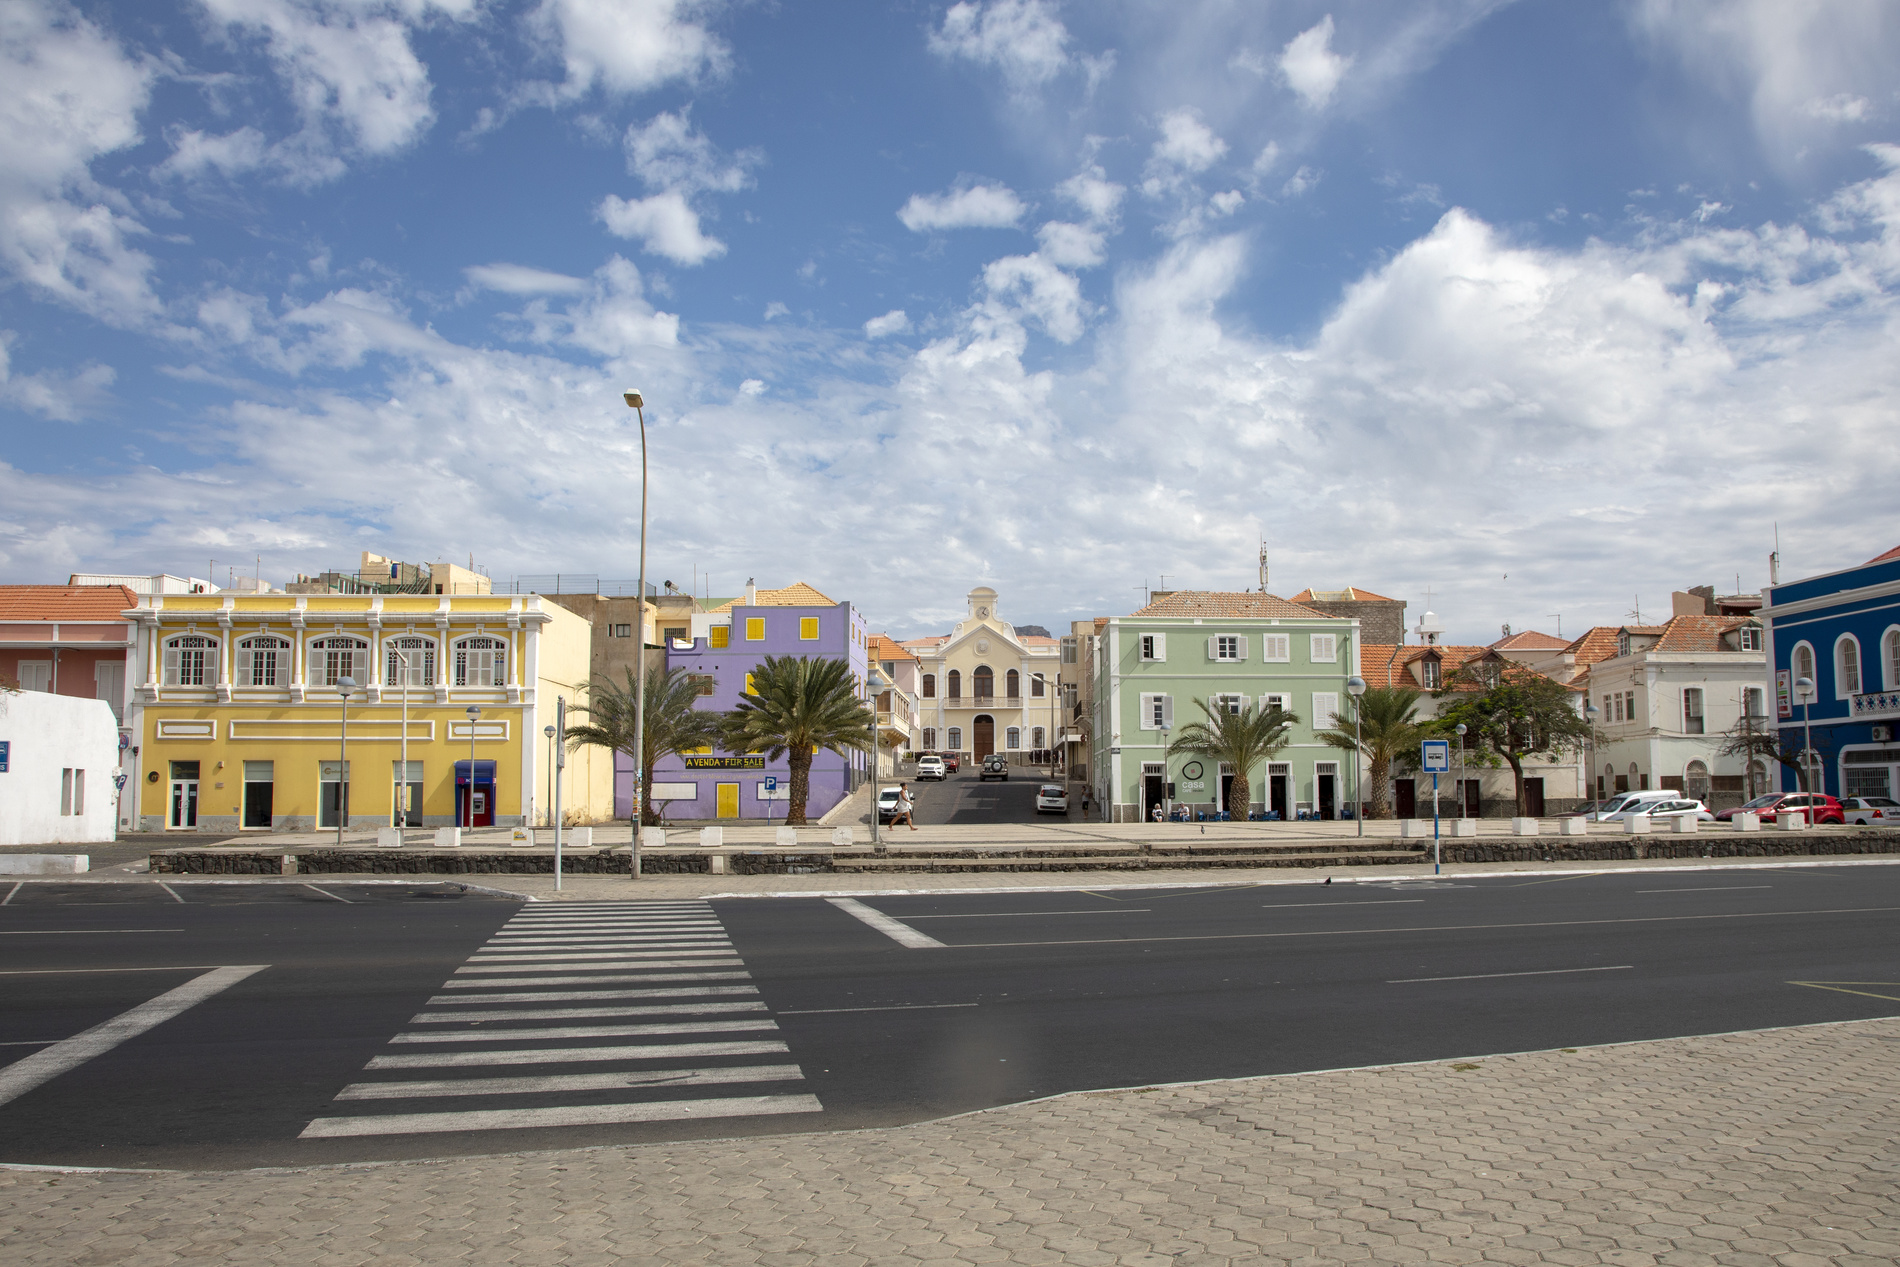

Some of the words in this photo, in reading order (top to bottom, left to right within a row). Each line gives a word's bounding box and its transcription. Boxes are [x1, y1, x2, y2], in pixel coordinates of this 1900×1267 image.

[694, 758, 720, 766] VENDA
[725, 758, 742, 766] FOR
[118, 776, 126, 786] P
[766, 778, 775, 788] P
